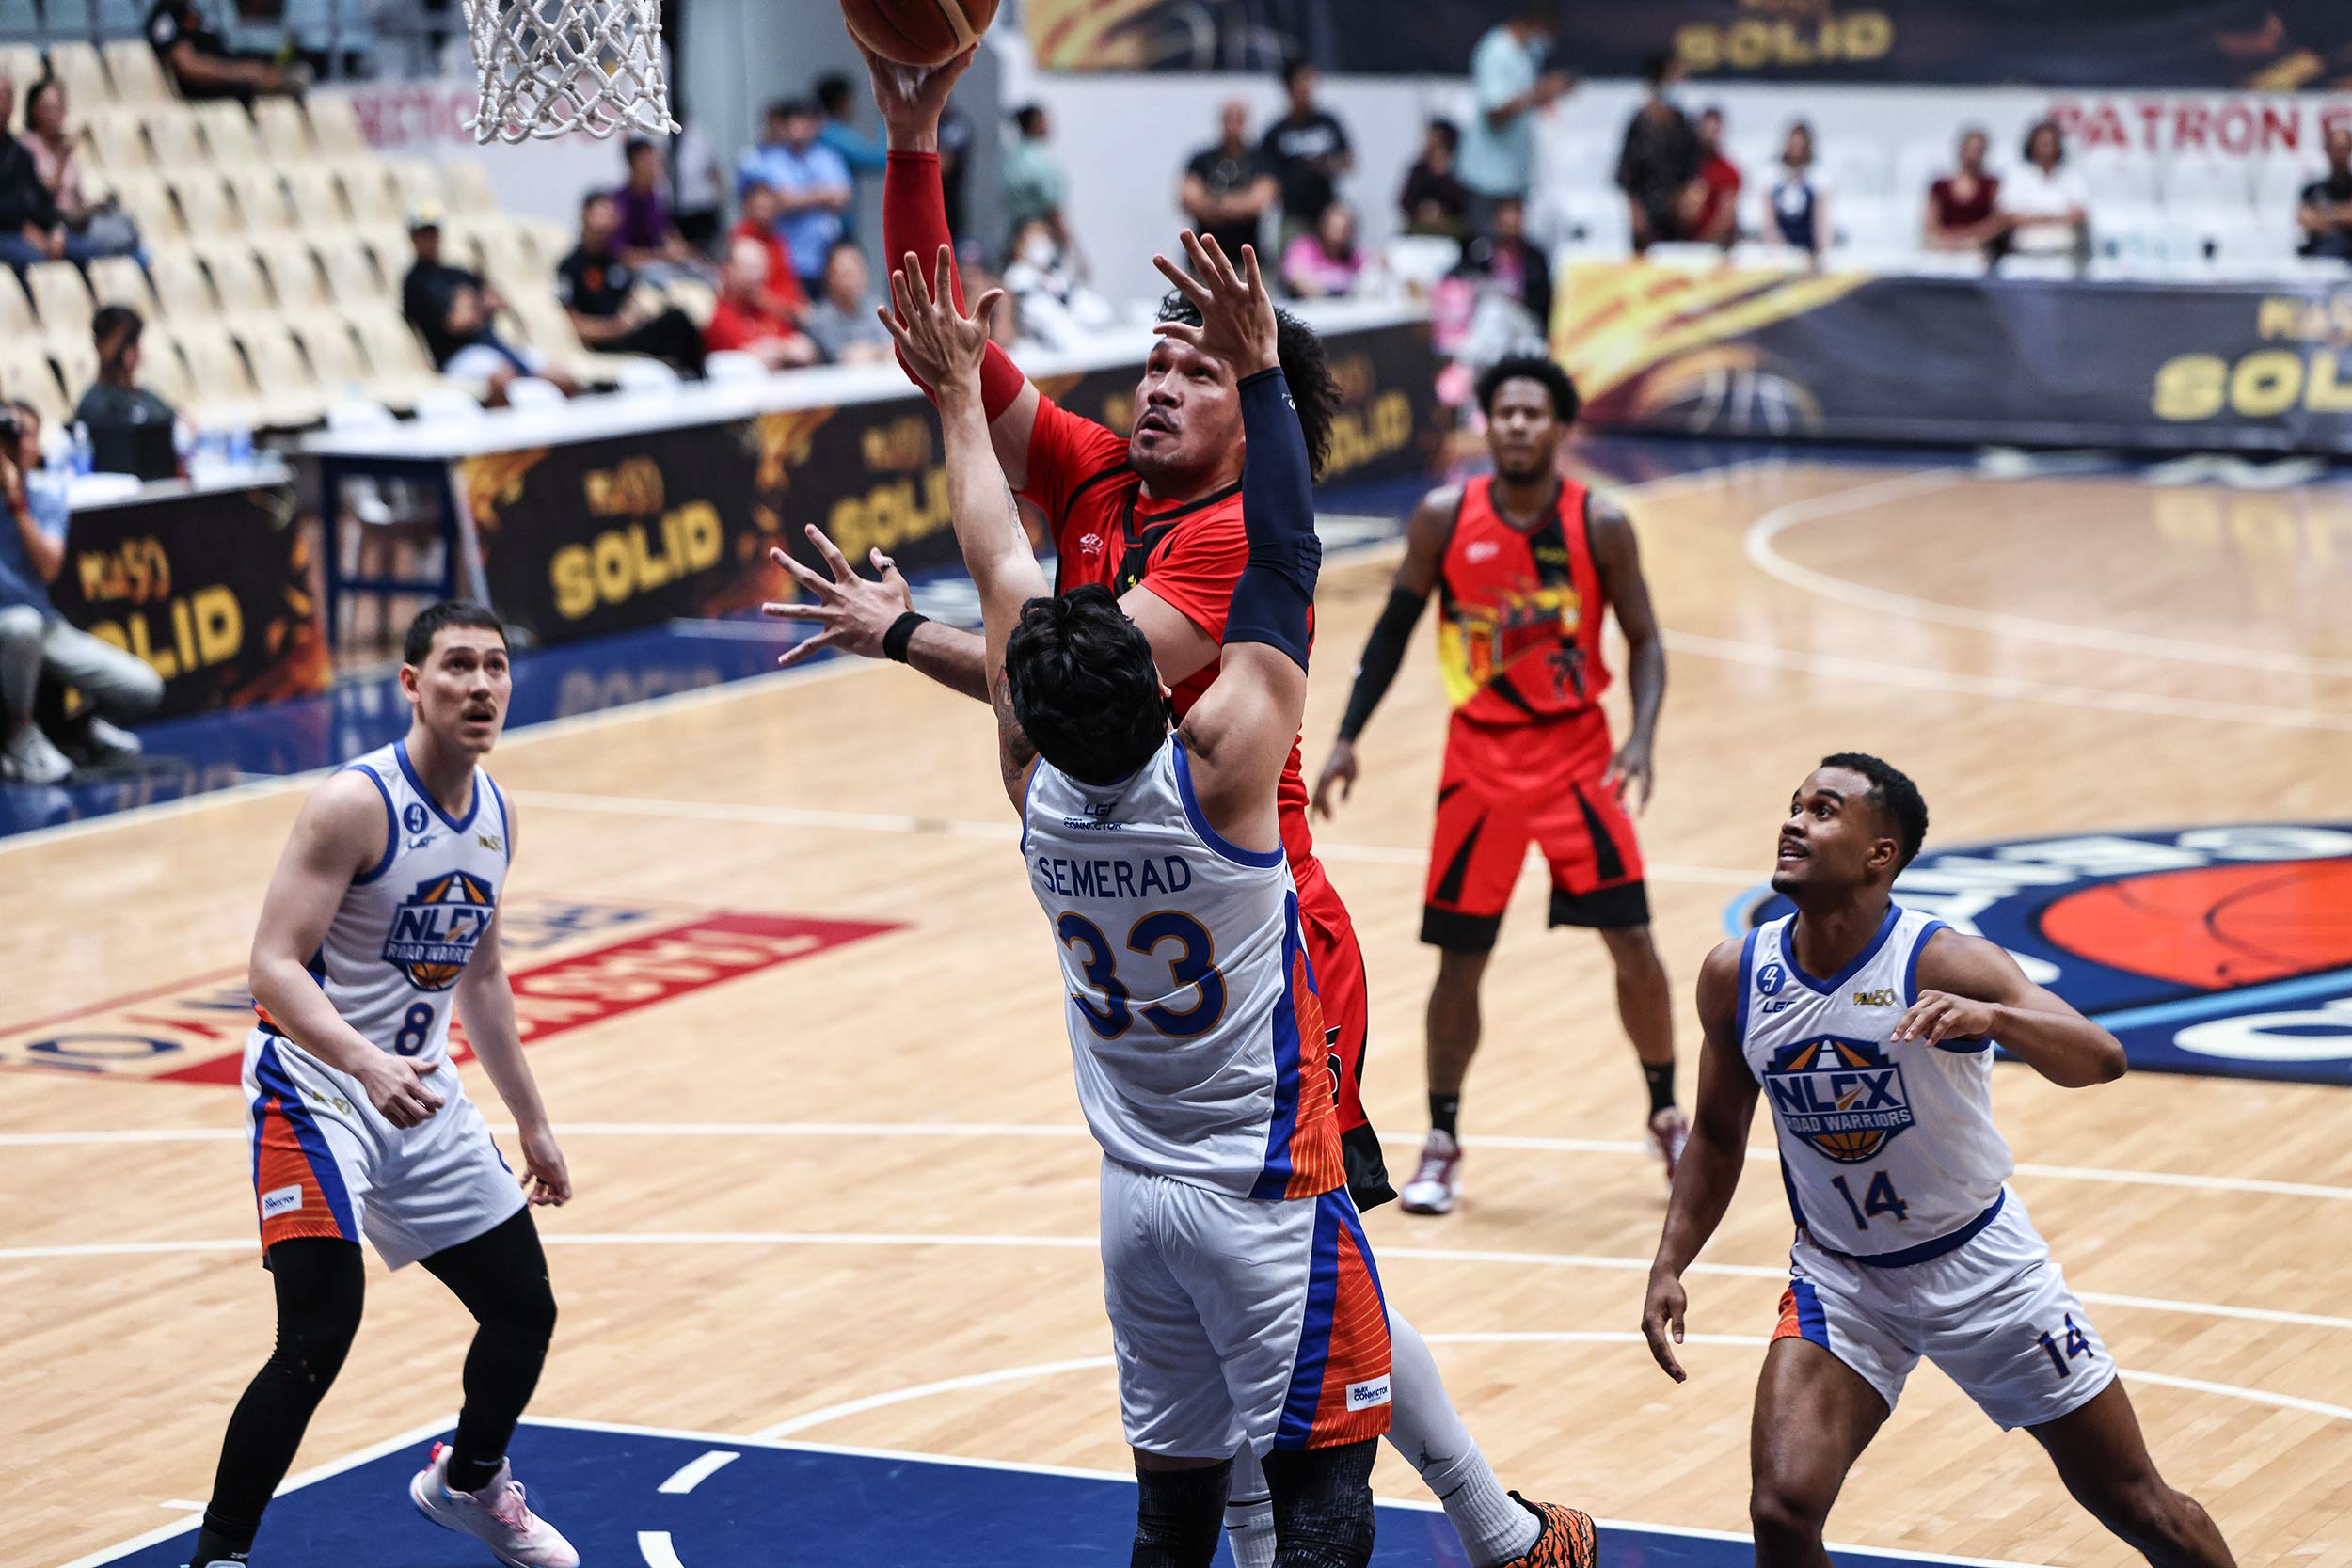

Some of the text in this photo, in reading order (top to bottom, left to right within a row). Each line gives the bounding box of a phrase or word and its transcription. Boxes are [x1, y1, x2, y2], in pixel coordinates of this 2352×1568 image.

[1675, 11, 1894, 71] SOLID
[1312, 390, 1413, 484] OLID
[828, 467, 951, 564] SOLI
[550, 499, 723, 621] SOLID
[1038, 854, 1192, 898] SEMERAD
[394, 907, 495, 942] NLEX
[1057, 910, 1228, 1041] 33
[394, 1002, 435, 1057] 8
[1771, 1070, 1902, 1113] NLEX
[1785, 1109, 1912, 1132] OAD WARRIORS
[1830, 1170, 1909, 1231] 14
[2037, 1311, 2095, 1380] 14
